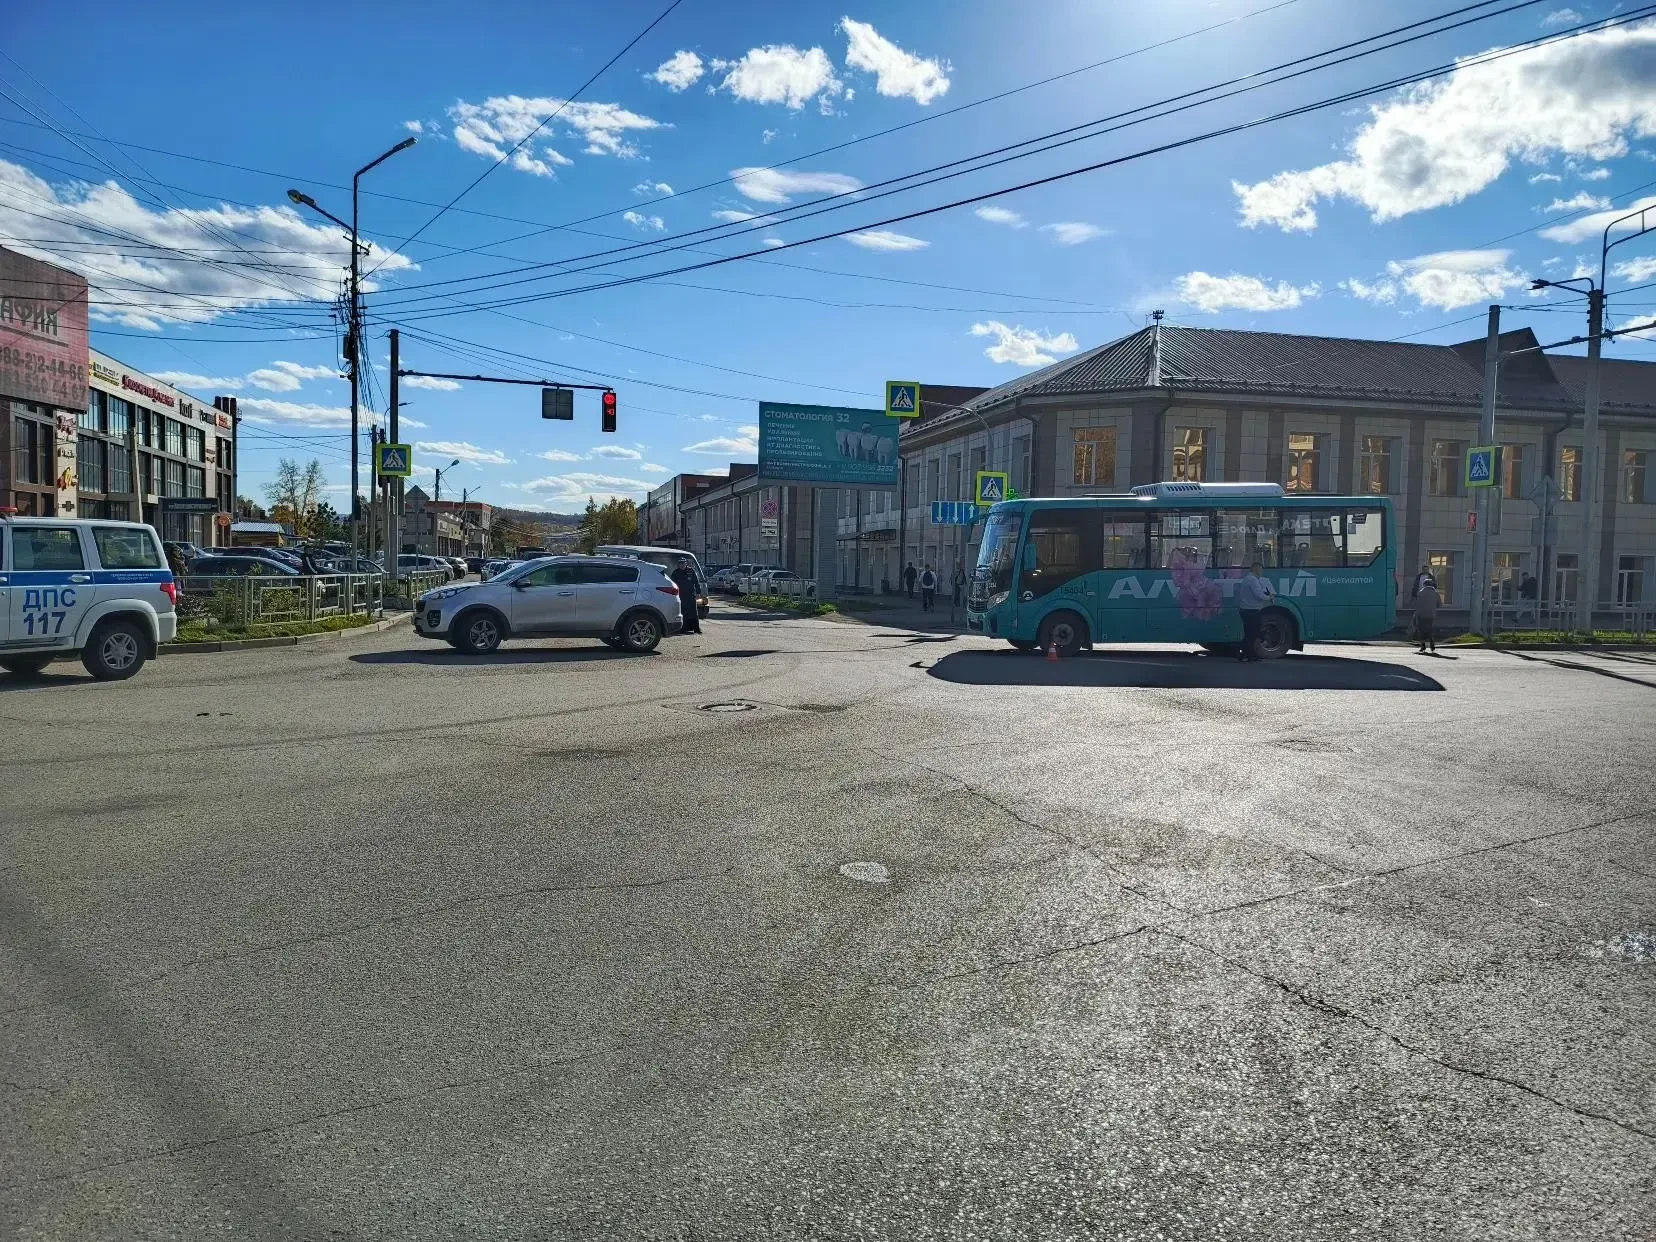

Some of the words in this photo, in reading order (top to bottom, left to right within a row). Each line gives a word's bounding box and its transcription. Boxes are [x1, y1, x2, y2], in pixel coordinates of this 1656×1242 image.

[0, 346, 84, 382] 88-2)2-44-66
[764, 410, 834, 422] СТОМАТОЛОГИЯ
[836, 413, 850, 423] 32
[22, 588, 77, 612] ДПС
[23, 611, 67, 636] 117
